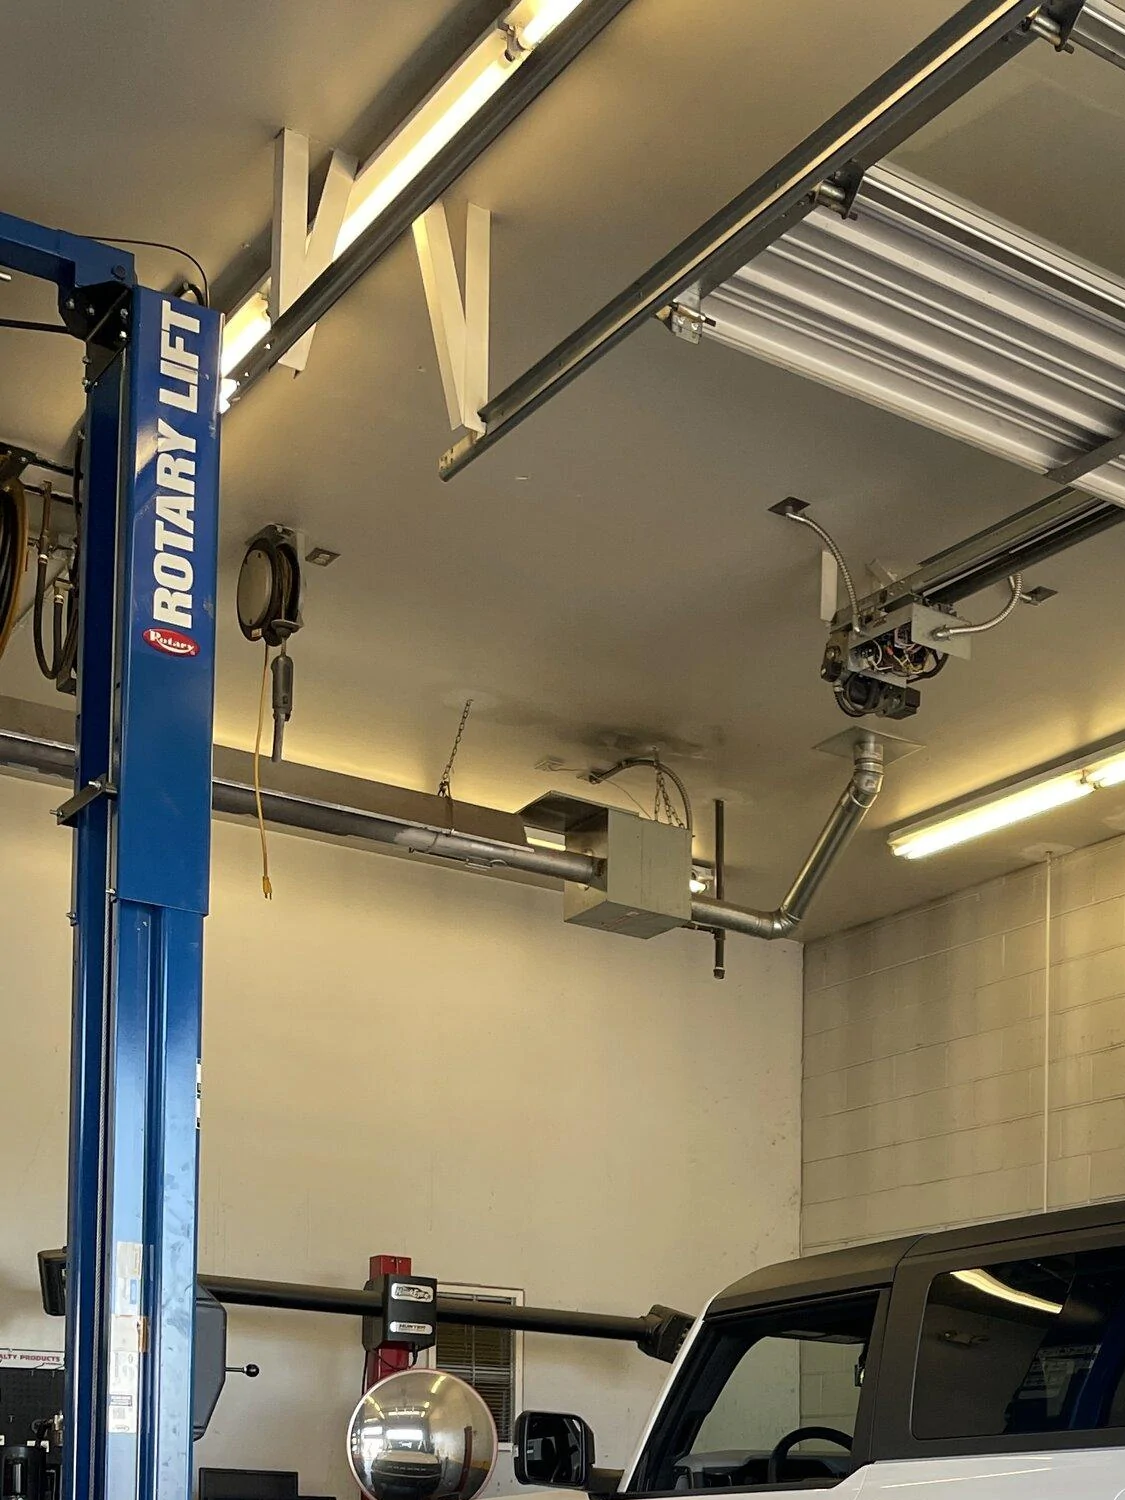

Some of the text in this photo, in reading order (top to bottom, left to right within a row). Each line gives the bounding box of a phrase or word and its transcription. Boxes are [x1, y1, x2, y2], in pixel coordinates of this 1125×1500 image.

[153, 299, 200, 629] ROTARY LIFT
[150, 629, 194, 652] Rotary
